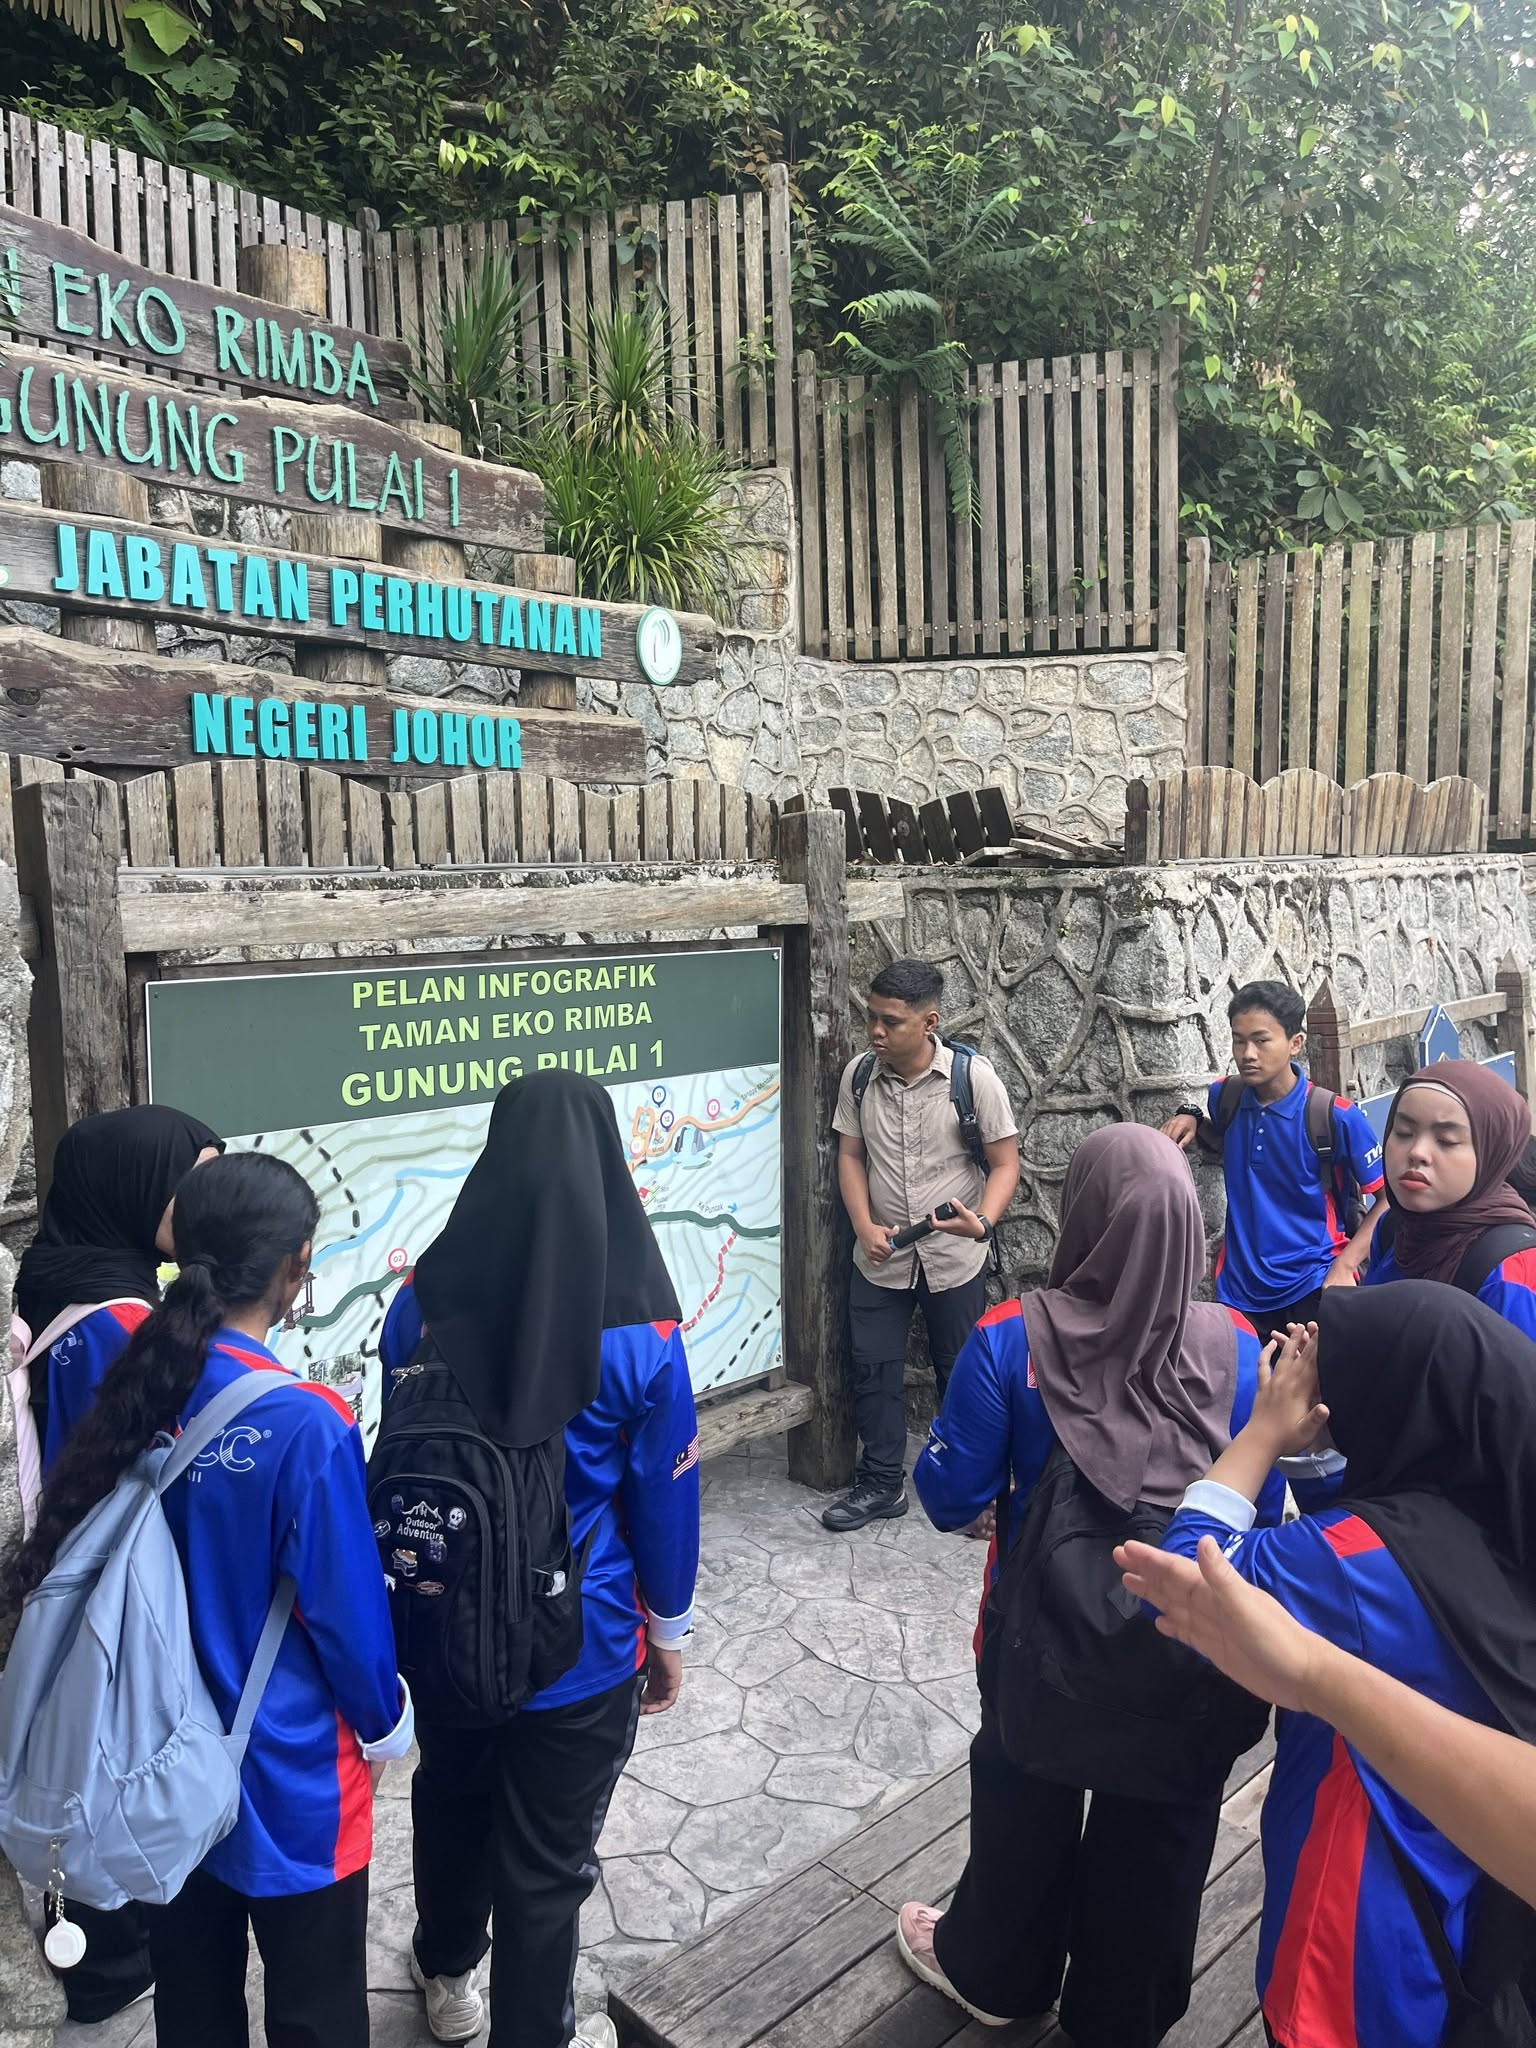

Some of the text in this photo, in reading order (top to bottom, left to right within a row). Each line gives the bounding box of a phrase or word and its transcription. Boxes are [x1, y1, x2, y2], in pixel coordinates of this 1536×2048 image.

[53, 262, 186, 355] EKO
[214, 306, 379, 405] RIMBA
[273, 425, 424, 520] PULAI
[449, 468, 461, 527] 1
[53, 524, 602, 660] JABATAN PERHUTANAN
[190, 692, 523, 769] NEGERI JOHOR
[352, 963, 657, 1009] PELAN INFOGRAFIK
[358, 1001, 653, 1051] TAMAN EKO RIMBA
[341, 1039, 664, 1106] GUNUNG PULAI 1
[396, 1523, 444, 1540] Adventure
[405, 1516, 438, 1531] Outdoor
